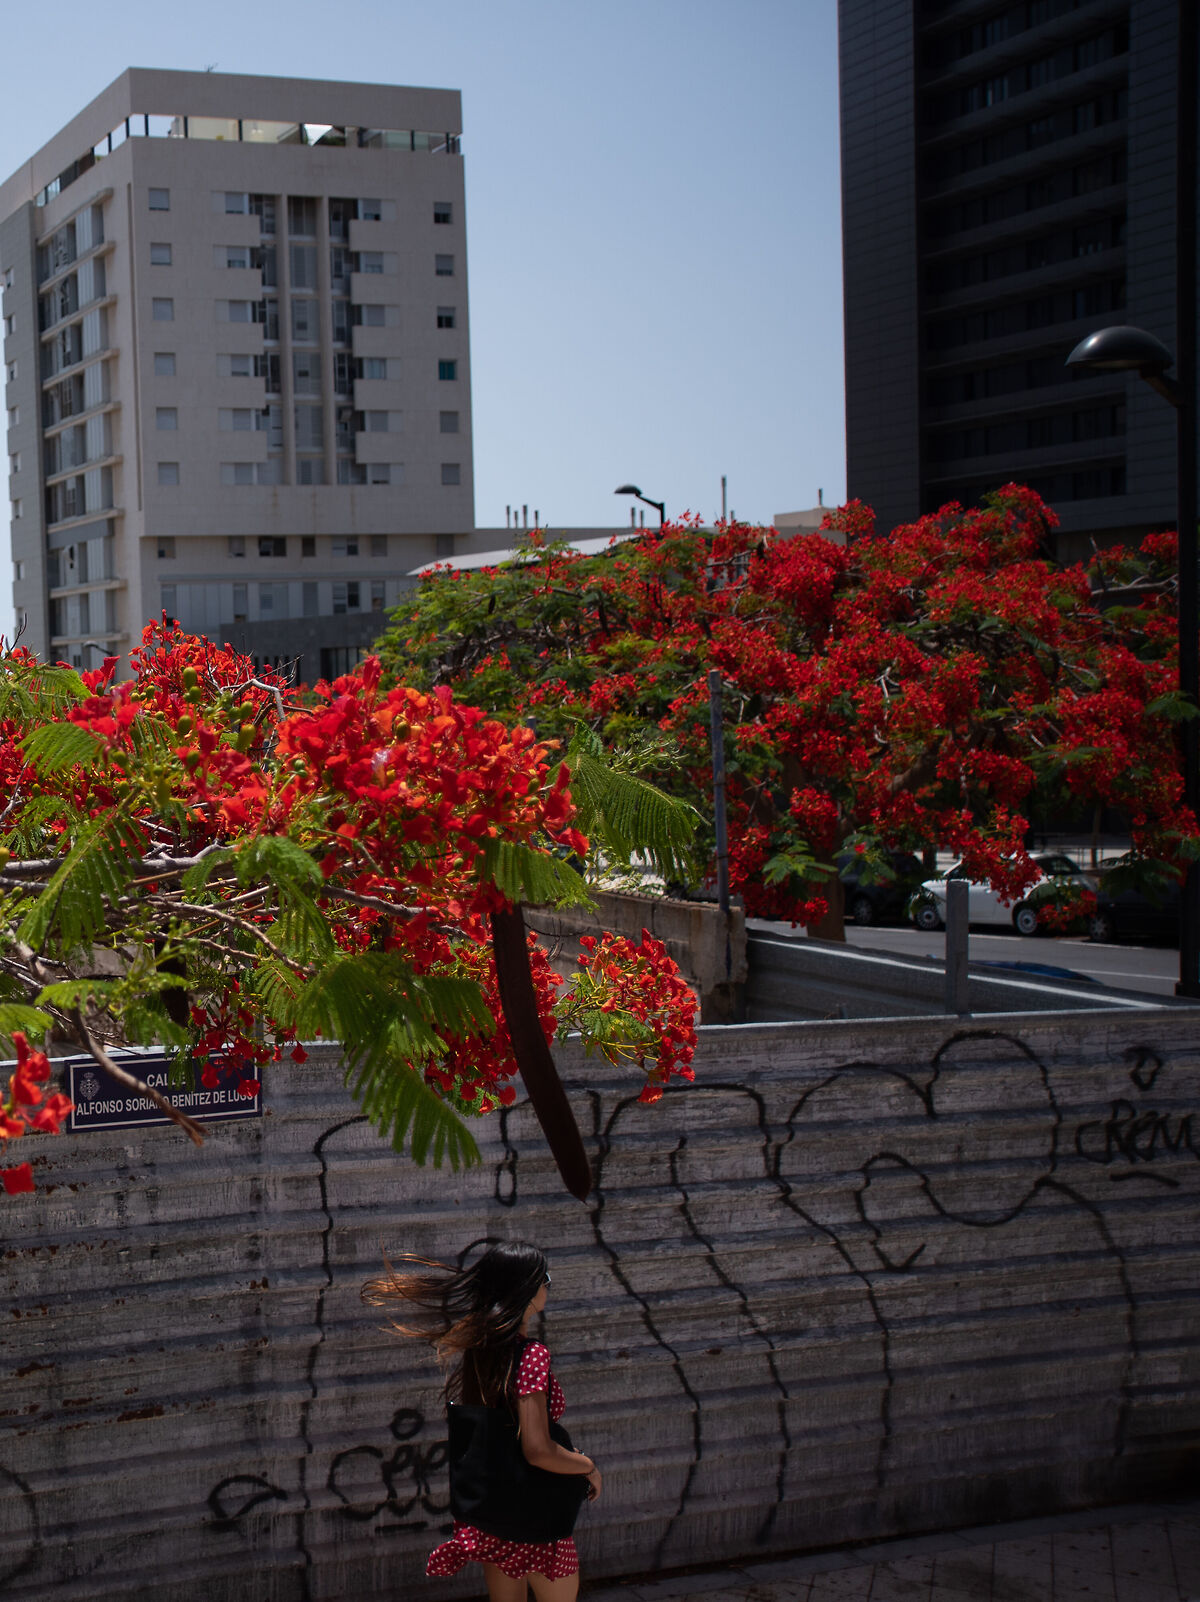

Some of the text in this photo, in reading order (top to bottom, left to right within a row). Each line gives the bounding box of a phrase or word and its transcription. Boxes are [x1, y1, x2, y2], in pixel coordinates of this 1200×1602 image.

[146, 1073, 186, 1087] CAL
[76, 1099, 123, 1116] ALFONSO
[125, 1096, 170, 1112] SORIAO
[171, 1090, 211, 1107] BENÍTEZ
[213, 1090, 226, 1104] DE
